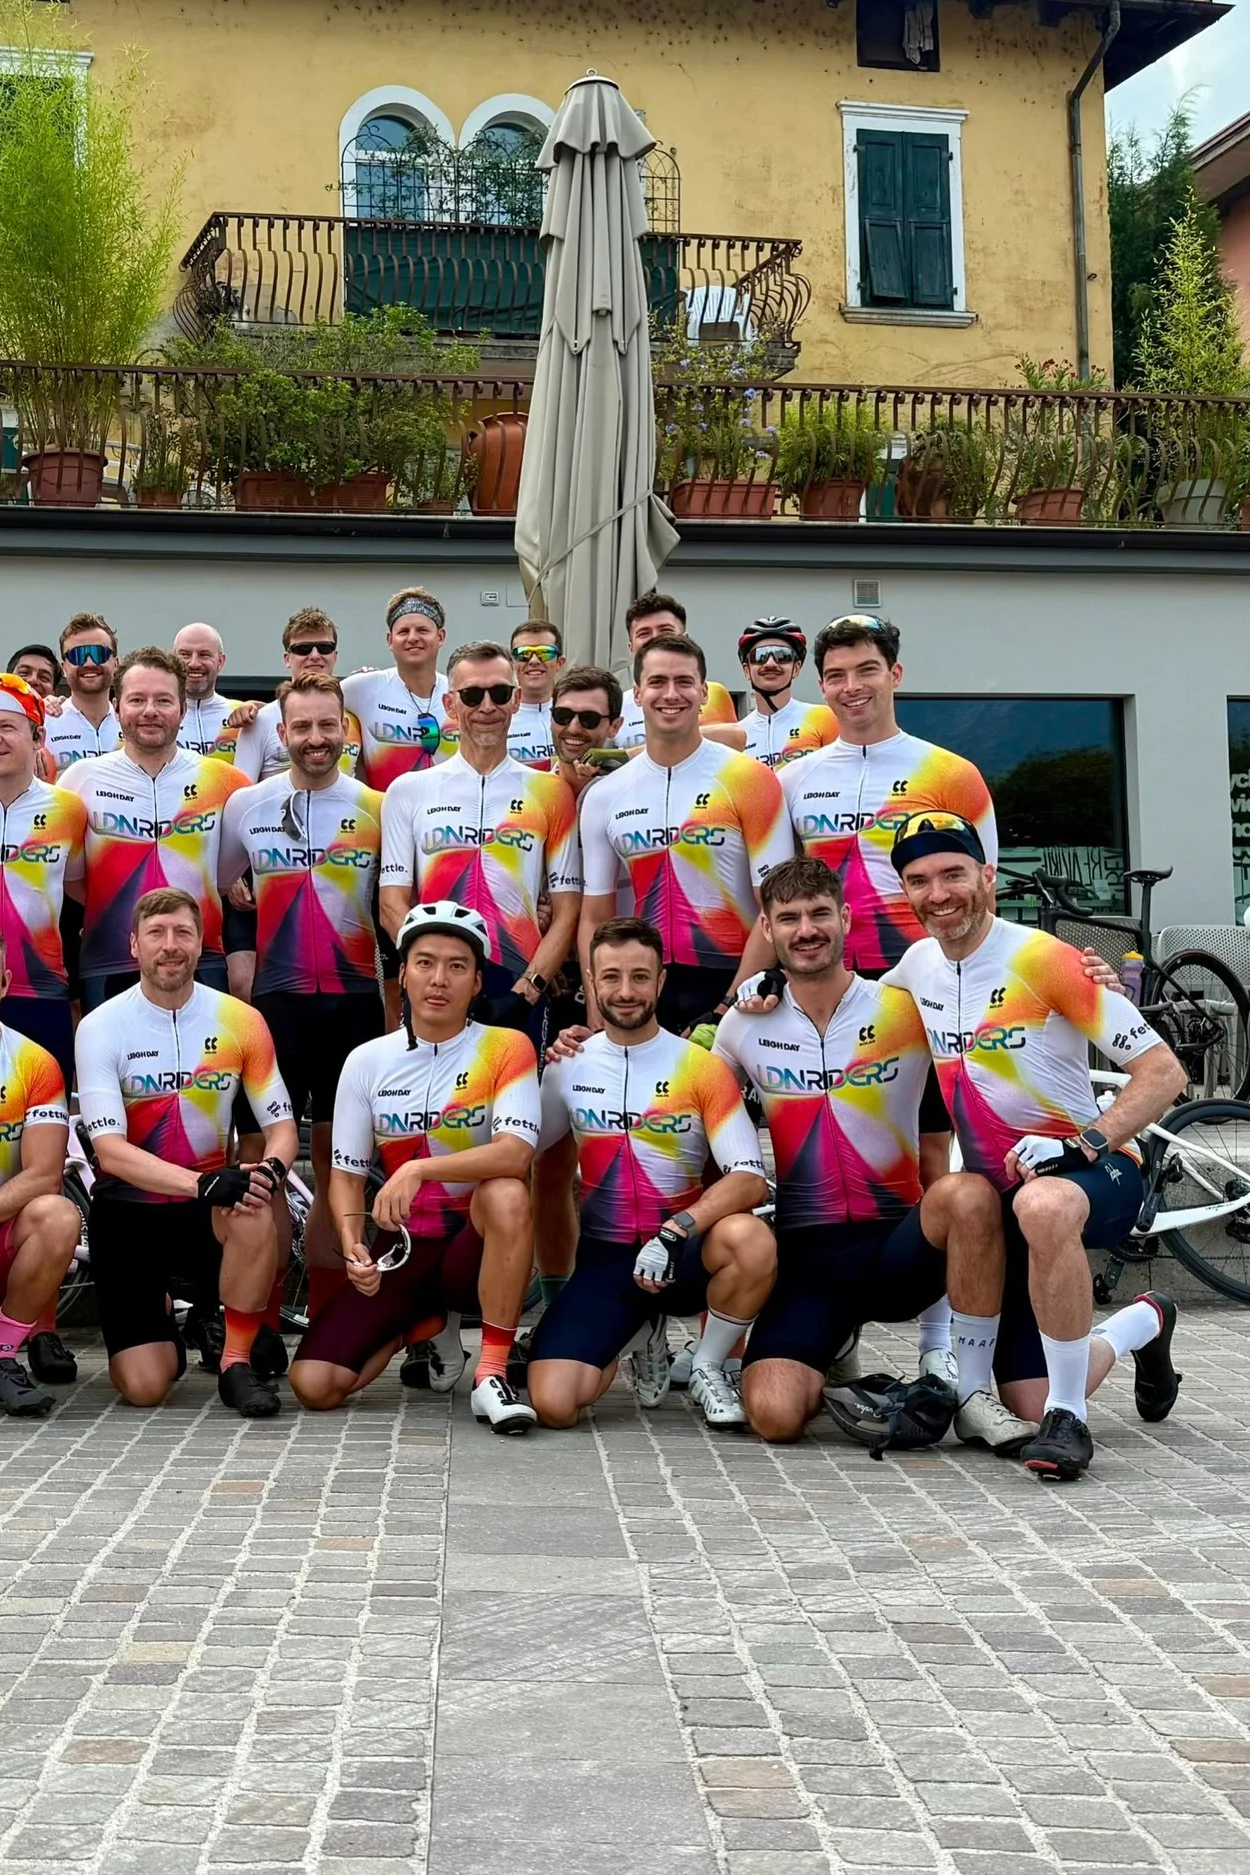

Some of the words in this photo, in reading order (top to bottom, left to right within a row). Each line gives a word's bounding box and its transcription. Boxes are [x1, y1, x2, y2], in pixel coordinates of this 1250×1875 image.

[93, 811, 216, 839] LDNRIDERS
[758, 1037, 783, 1050] LEIGH
[756, 1056, 900, 1091] LDNRIDERS
